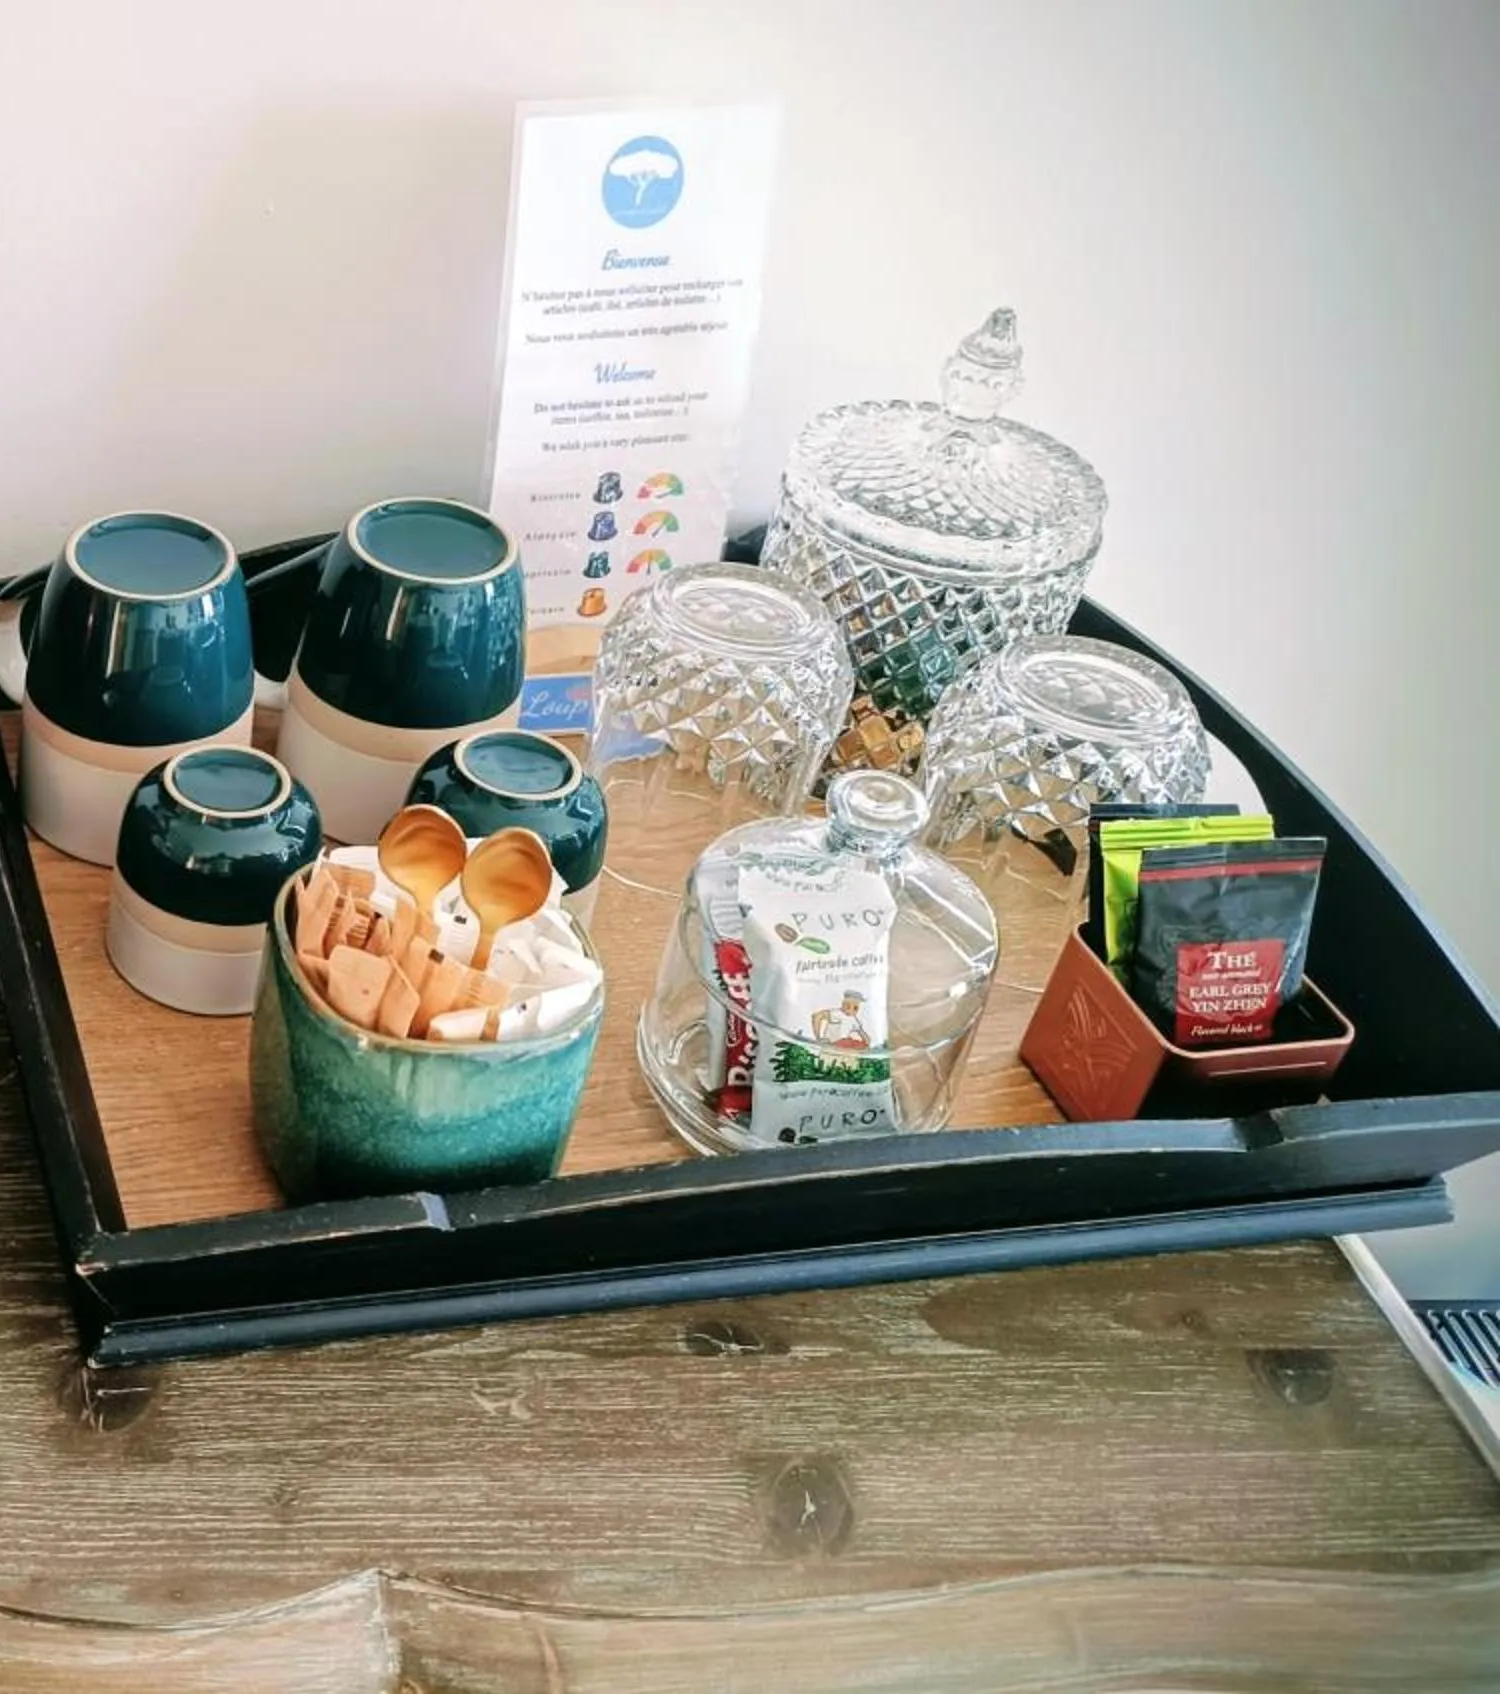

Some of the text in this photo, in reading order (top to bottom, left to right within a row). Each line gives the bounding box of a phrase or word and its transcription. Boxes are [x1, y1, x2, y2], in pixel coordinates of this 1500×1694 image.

[600, 247, 671, 272] Bienvenue
[593, 359, 657, 384] Welcome
[520, 689, 589, 721] Loup
[791, 908, 885, 933] PURO
[795, 954, 849, 975] fairtrade
[1188, 982, 1272, 999] EARL GREY
[1191, 997, 1268, 1013] YIN ZHEN
[799, 1108, 885, 1134] PURO
